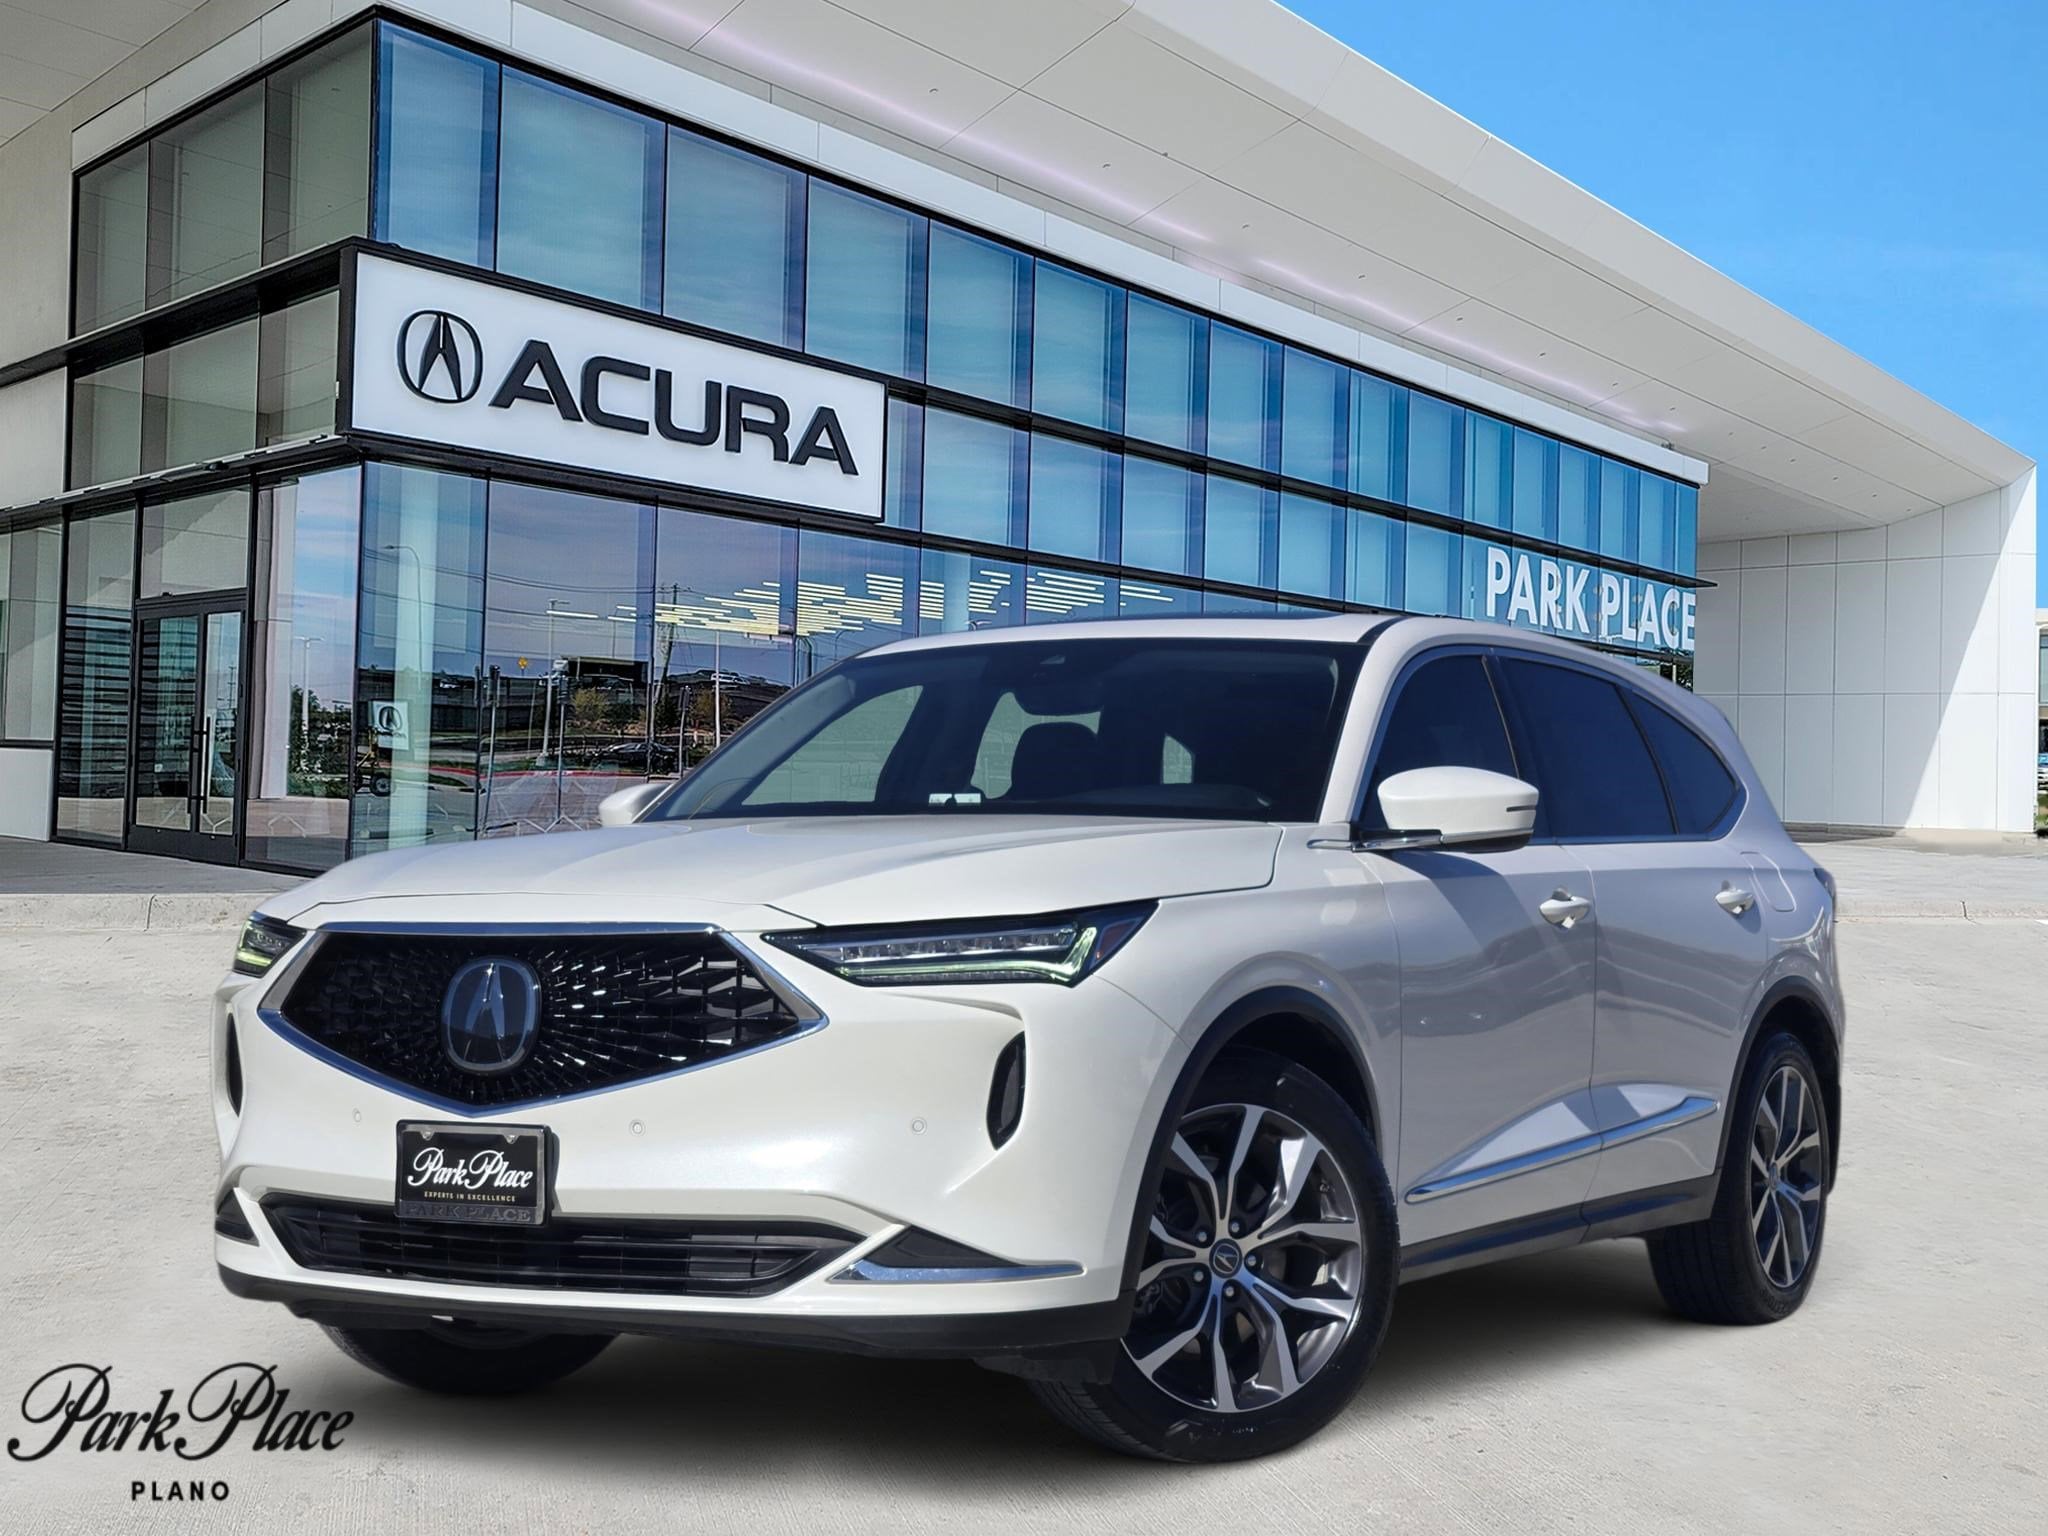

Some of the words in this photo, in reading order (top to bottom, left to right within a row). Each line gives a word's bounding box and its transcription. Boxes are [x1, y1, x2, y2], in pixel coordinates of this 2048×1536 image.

[488, 339, 859, 476] ACURA
[1486, 546, 1590, 634] PARK
[1600, 573, 1697, 651] PLACE
[407, 1147, 467, 1187] Park
[464, 1150, 533, 1190] Place
[424, 1191, 454, 1199] EXPERTS
[467, 1194, 516, 1203] EXCELLENCE
[466, 1206, 532, 1222] PLACE
